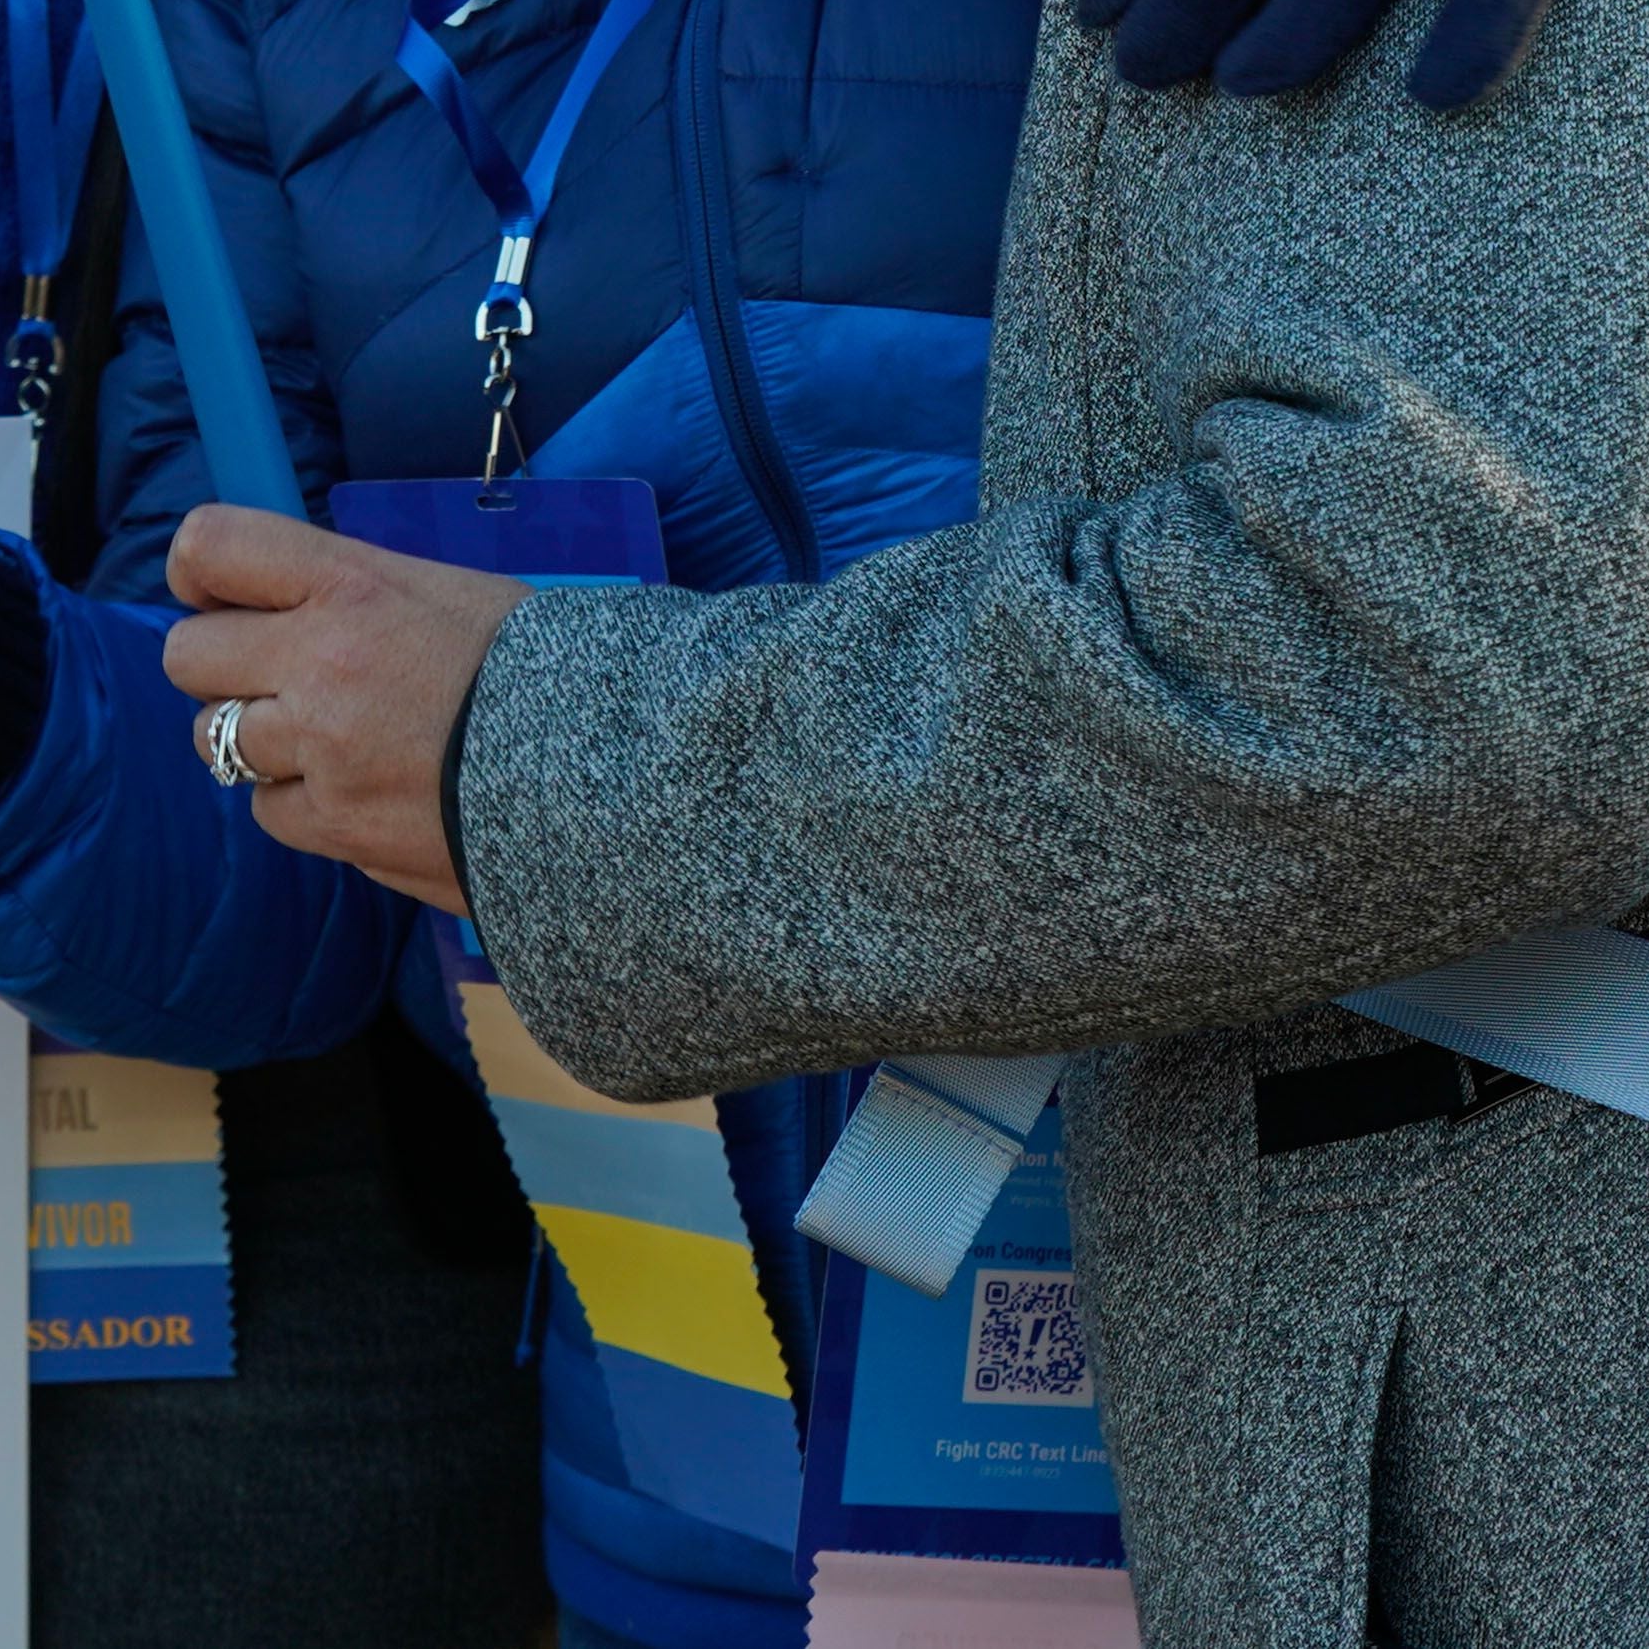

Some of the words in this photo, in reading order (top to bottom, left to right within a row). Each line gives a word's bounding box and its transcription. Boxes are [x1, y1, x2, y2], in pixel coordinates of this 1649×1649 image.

[28, 1200, 134, 1250] VIVOR
[27, 1314, 195, 1352] SSADOR
[935, 1438, 981, 1463] Fight
[986, 1441, 1024, 1461] CRC
[1029, 1443, 1067, 1463] Text
[1071, 1445, 1110, 1465] Line
